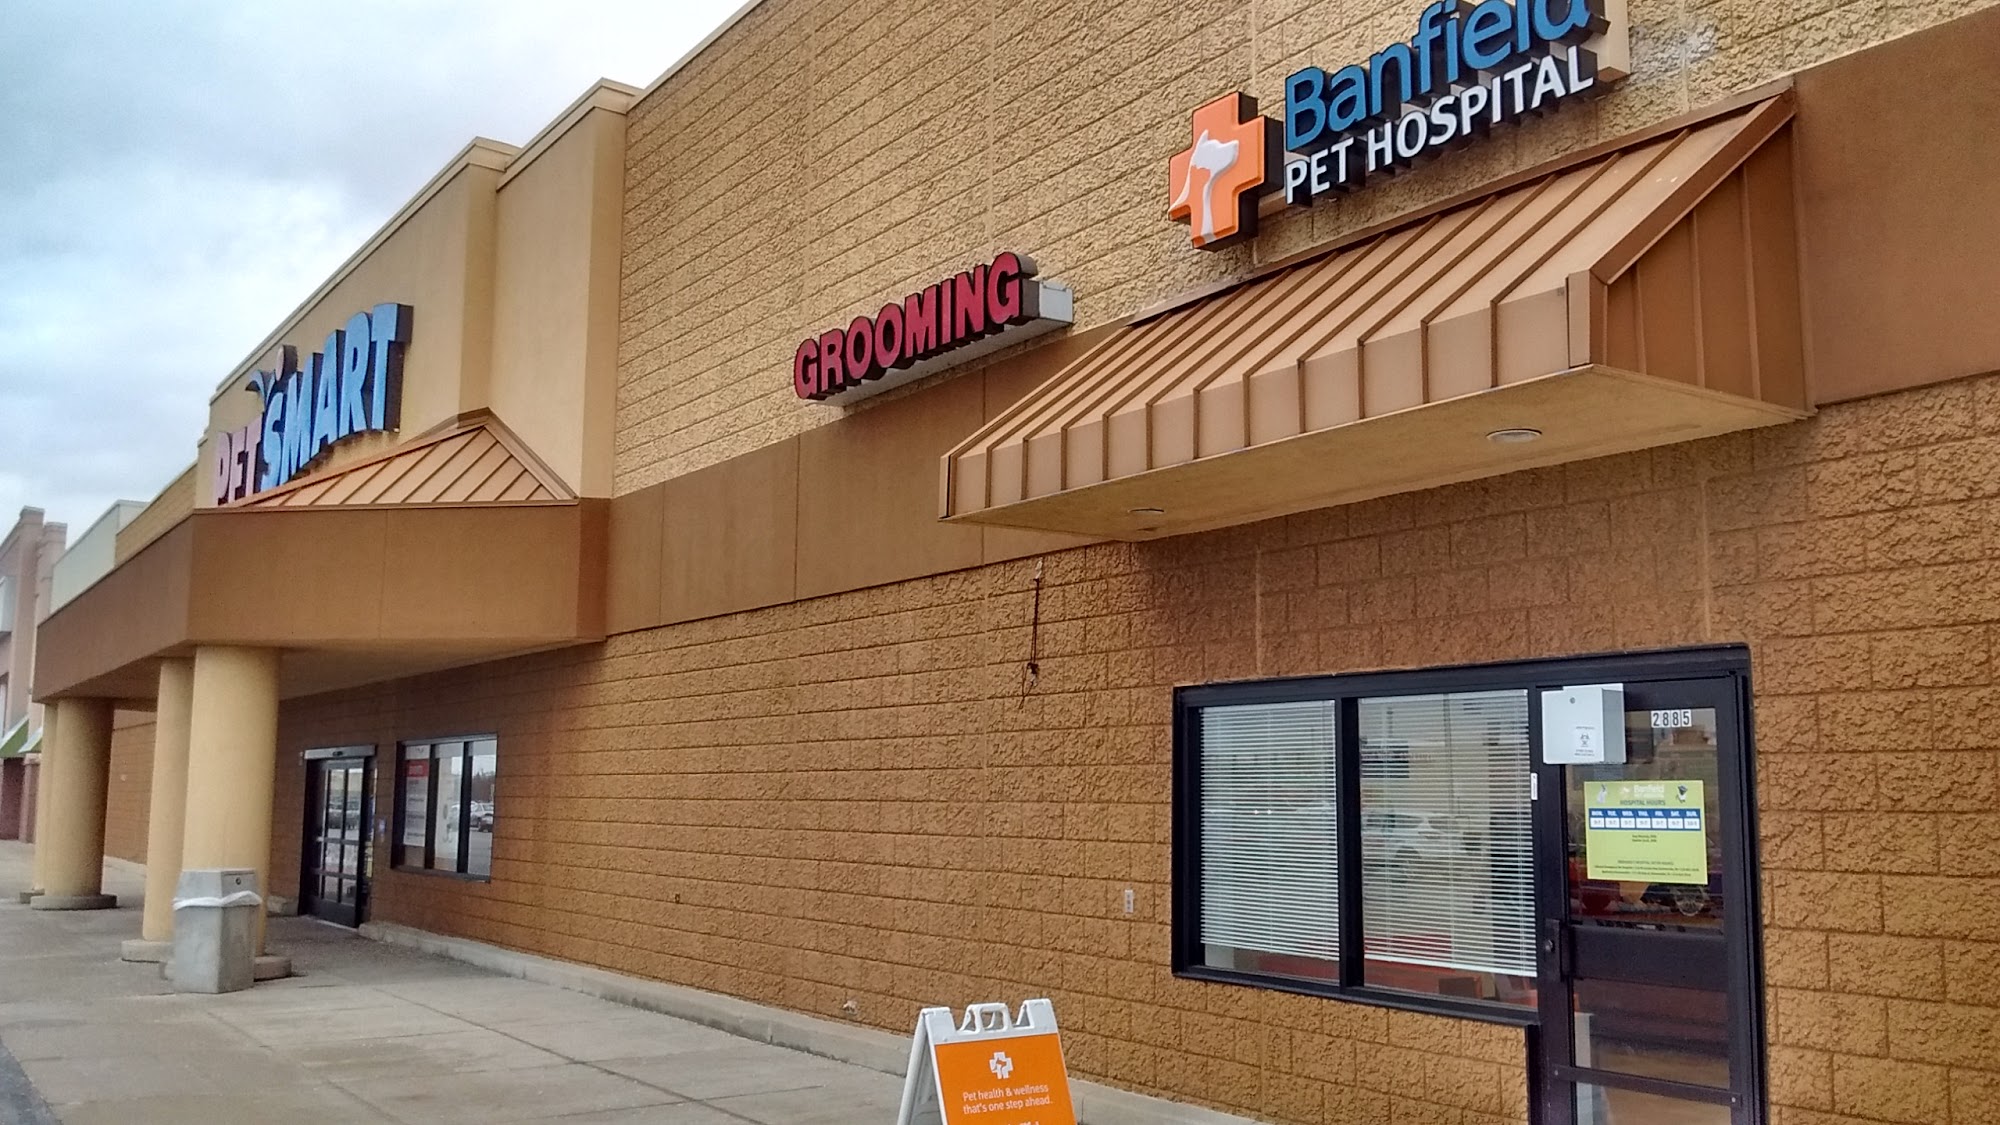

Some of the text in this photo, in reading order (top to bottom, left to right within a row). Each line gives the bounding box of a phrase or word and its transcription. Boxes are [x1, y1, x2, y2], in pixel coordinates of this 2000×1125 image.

[1285, 45, 1594, 205] PET HOSPITAL
[794, 251, 1022, 400] GROOMING
[1653, 711, 1690, 726] 2885
[963, 1084, 1049, 1102] Pet health & wellness
[963, 1095, 1053, 1115] that's one step ahead.
